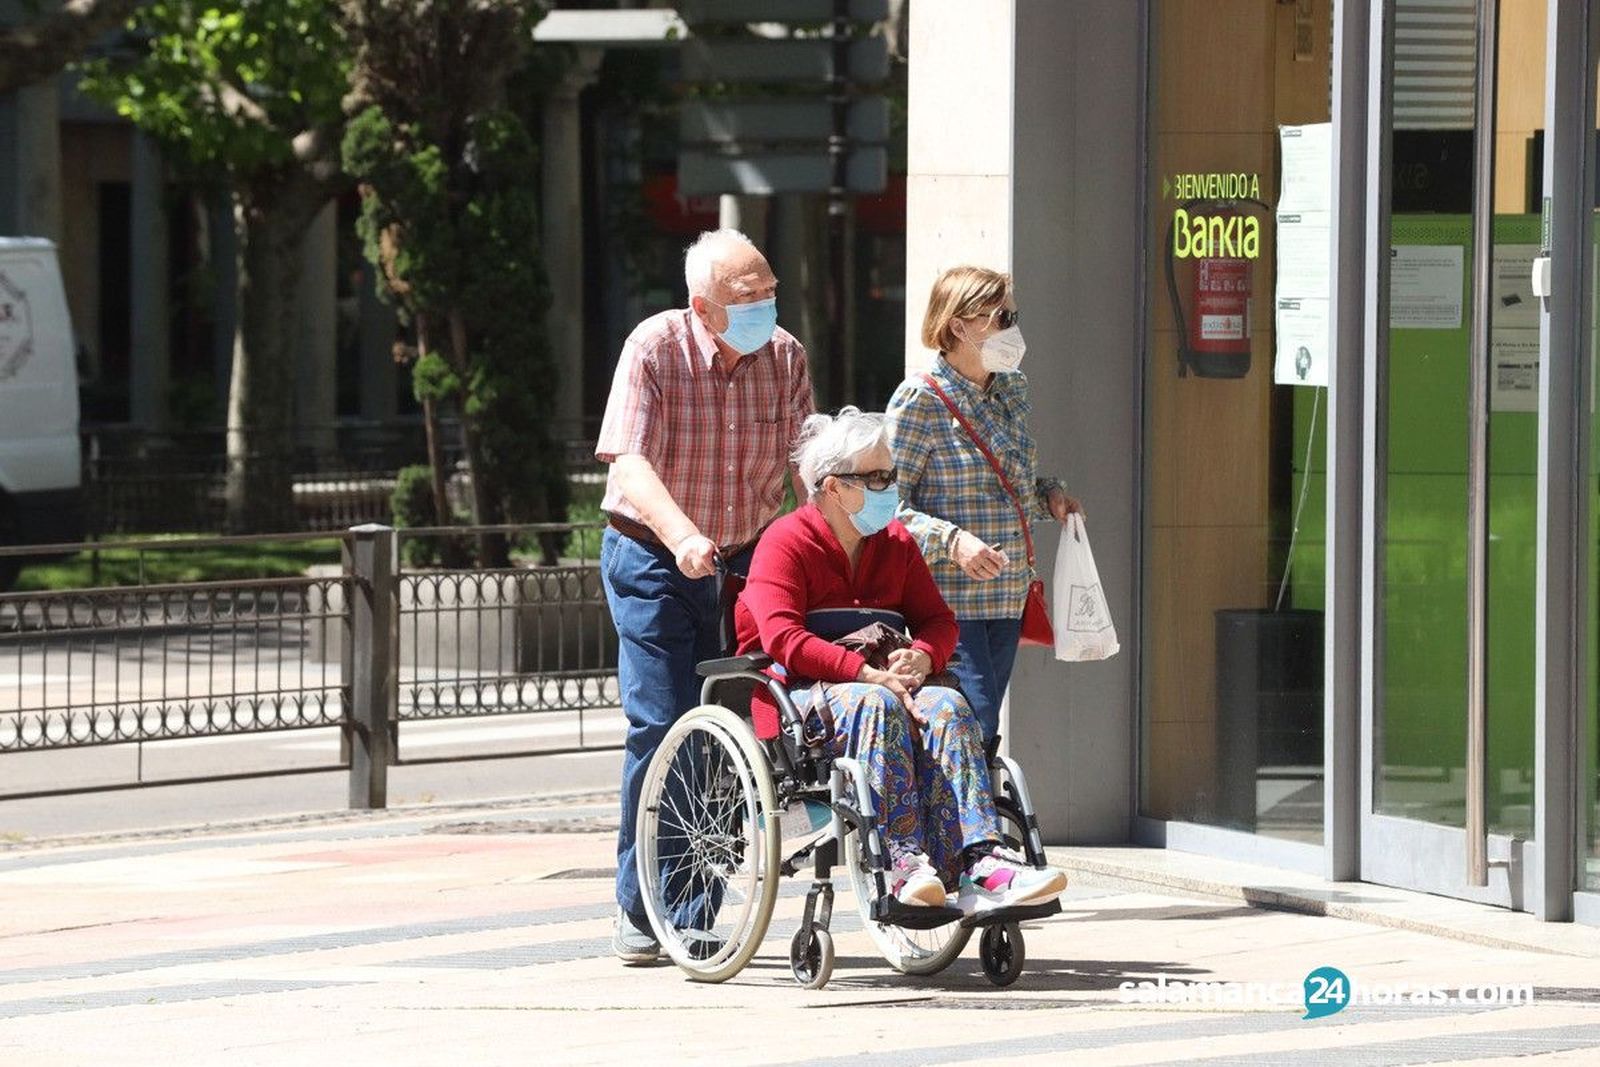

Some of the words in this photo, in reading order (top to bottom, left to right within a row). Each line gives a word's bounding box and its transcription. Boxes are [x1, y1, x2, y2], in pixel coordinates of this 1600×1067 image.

[1175, 173, 1248, 200] BIENVENIDO
[1251, 174, 1260, 199] A
[1173, 208, 1260, 258] Bankia
